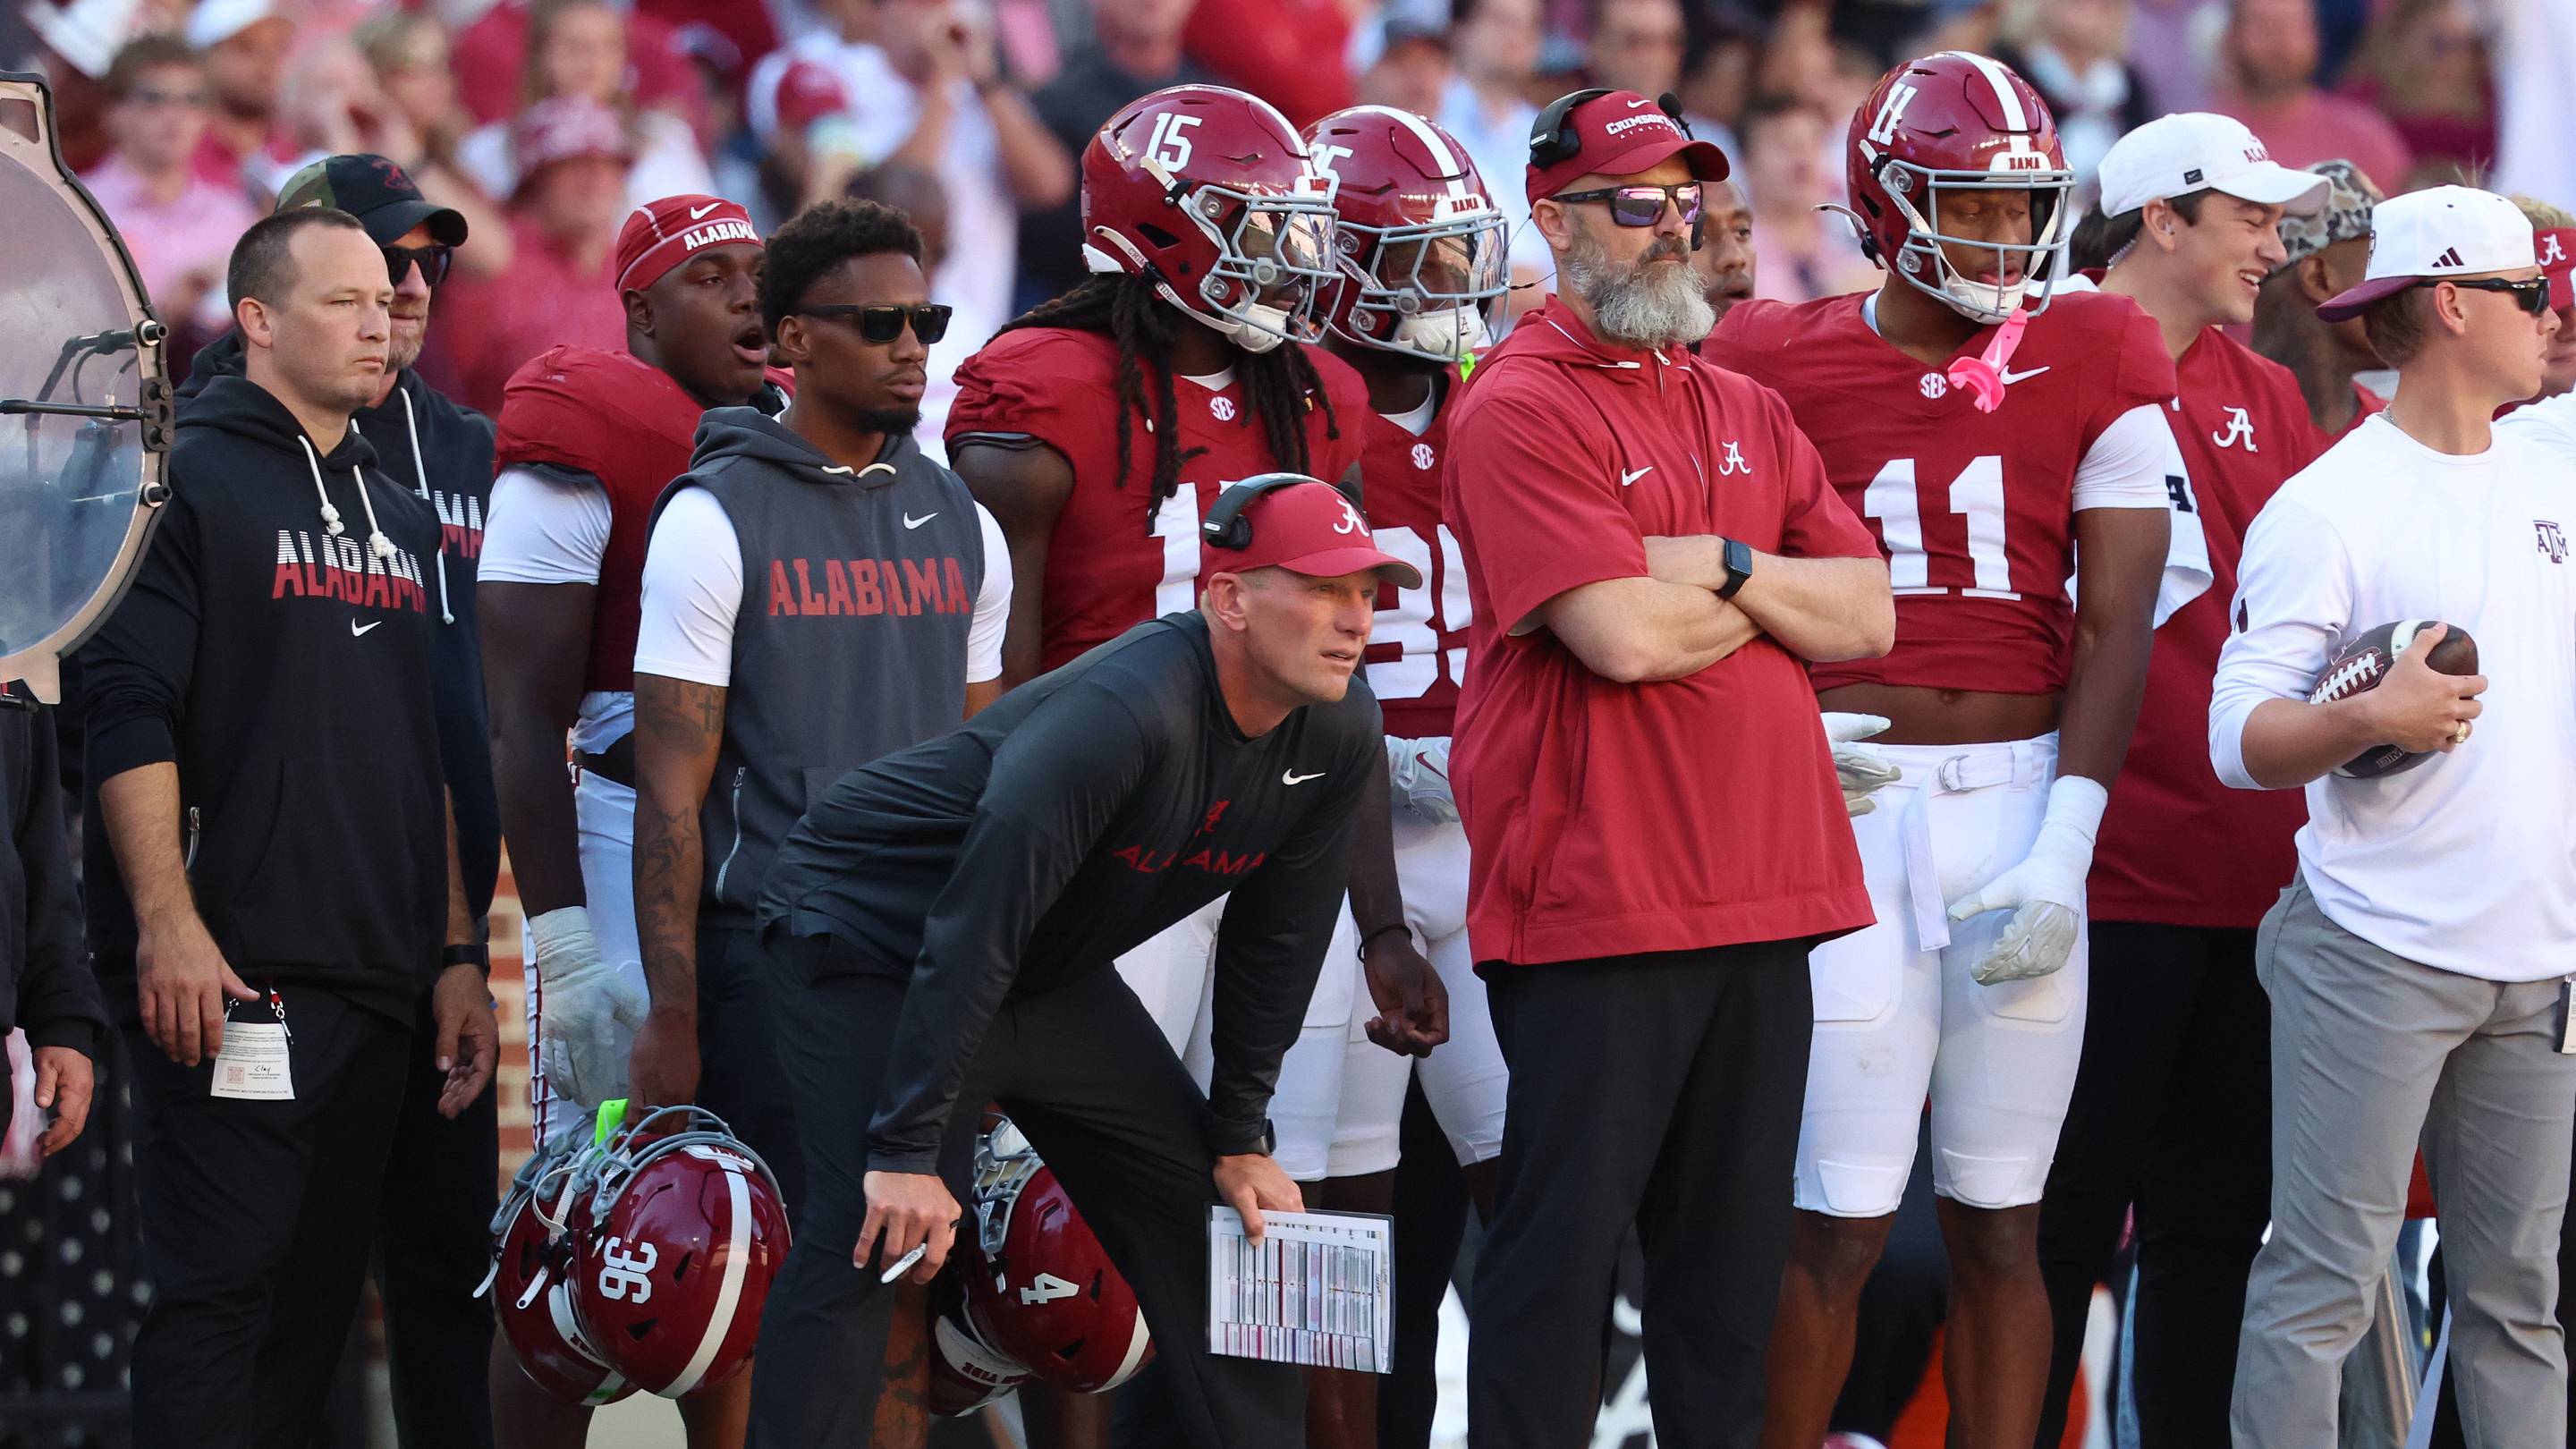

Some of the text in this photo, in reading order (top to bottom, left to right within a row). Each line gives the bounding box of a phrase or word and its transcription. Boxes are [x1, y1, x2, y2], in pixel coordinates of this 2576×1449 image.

[1606, 114, 1665, 135] CRIMSON
[1868, 82, 1918, 146] 11
[1145, 113, 1202, 173] 15
[2009, 157, 2040, 170] BAMA
[1451, 197, 1479, 214] BAMA
[683, 223, 759, 251] ALABAMA
[2539, 233, 2566, 266] A
[1919, 372, 1947, 399] SEC
[1210, 396, 1235, 421] SEC
[2213, 405, 2258, 452] A
[1411, 443, 1435, 470] SEC
[1719, 441, 1751, 476] A
[1333, 499, 1369, 537] A
[1864, 454, 2021, 601] 11
[768, 557, 970, 616] ALABAMA
[599, 1236, 657, 1304] 36
[1020, 1272, 1080, 1305] 4
